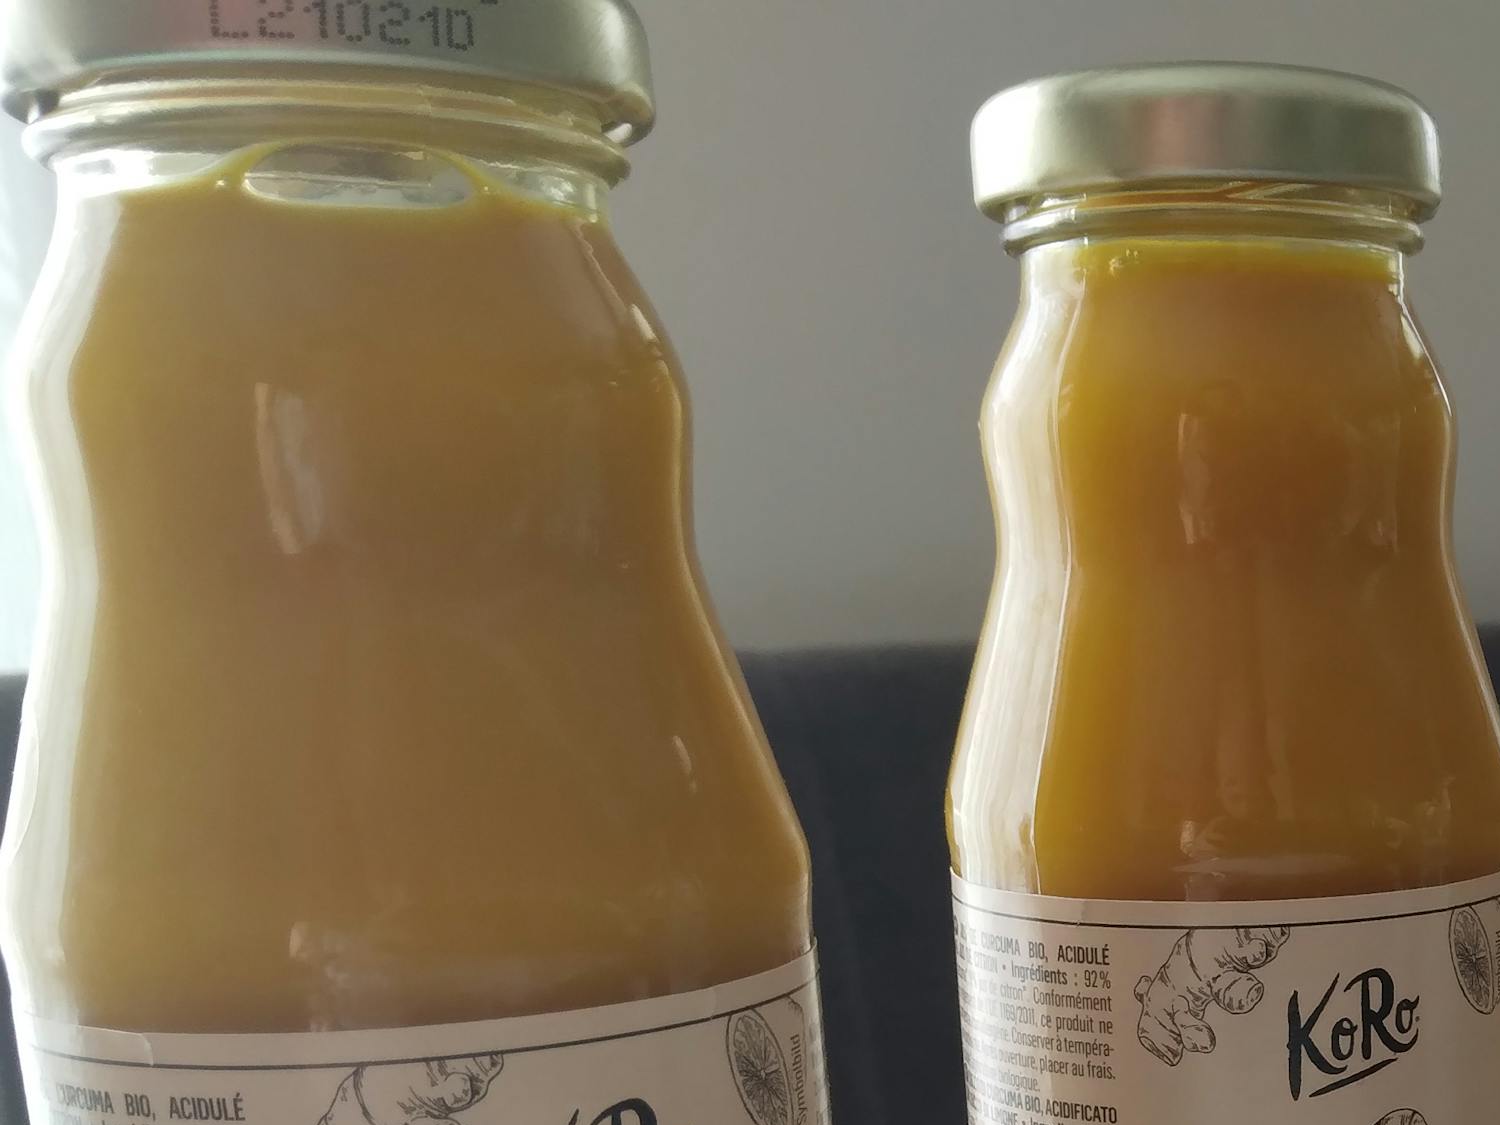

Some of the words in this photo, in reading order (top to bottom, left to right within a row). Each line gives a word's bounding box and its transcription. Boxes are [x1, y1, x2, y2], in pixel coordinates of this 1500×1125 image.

[1028, 941, 1048, 962] BIO,
[1058, 943, 1110, 966] ACIDULÉ
[1011, 960, 1068, 986] Ingrédients
[1033, 986, 1112, 1012] Conformément
[1041, 1015, 1051, 1029] ce
[1056, 1013, 1094, 1033] produit
[1099, 1021, 1113, 1035] ne
[1287, 968, 1420, 1101] KoRo
[1011, 1026, 1054, 1050] Conserver
[1040, 1054, 1068, 1076] placer
[1072, 1063, 1084, 1077] au
[1087, 1062, 1116, 1080] frais.
[124, 1093, 156, 1121] BIO,
[169, 1091, 246, 1122] ACIDULÉ
[1046, 1099, 1117, 1124] ACIDIFICATO
